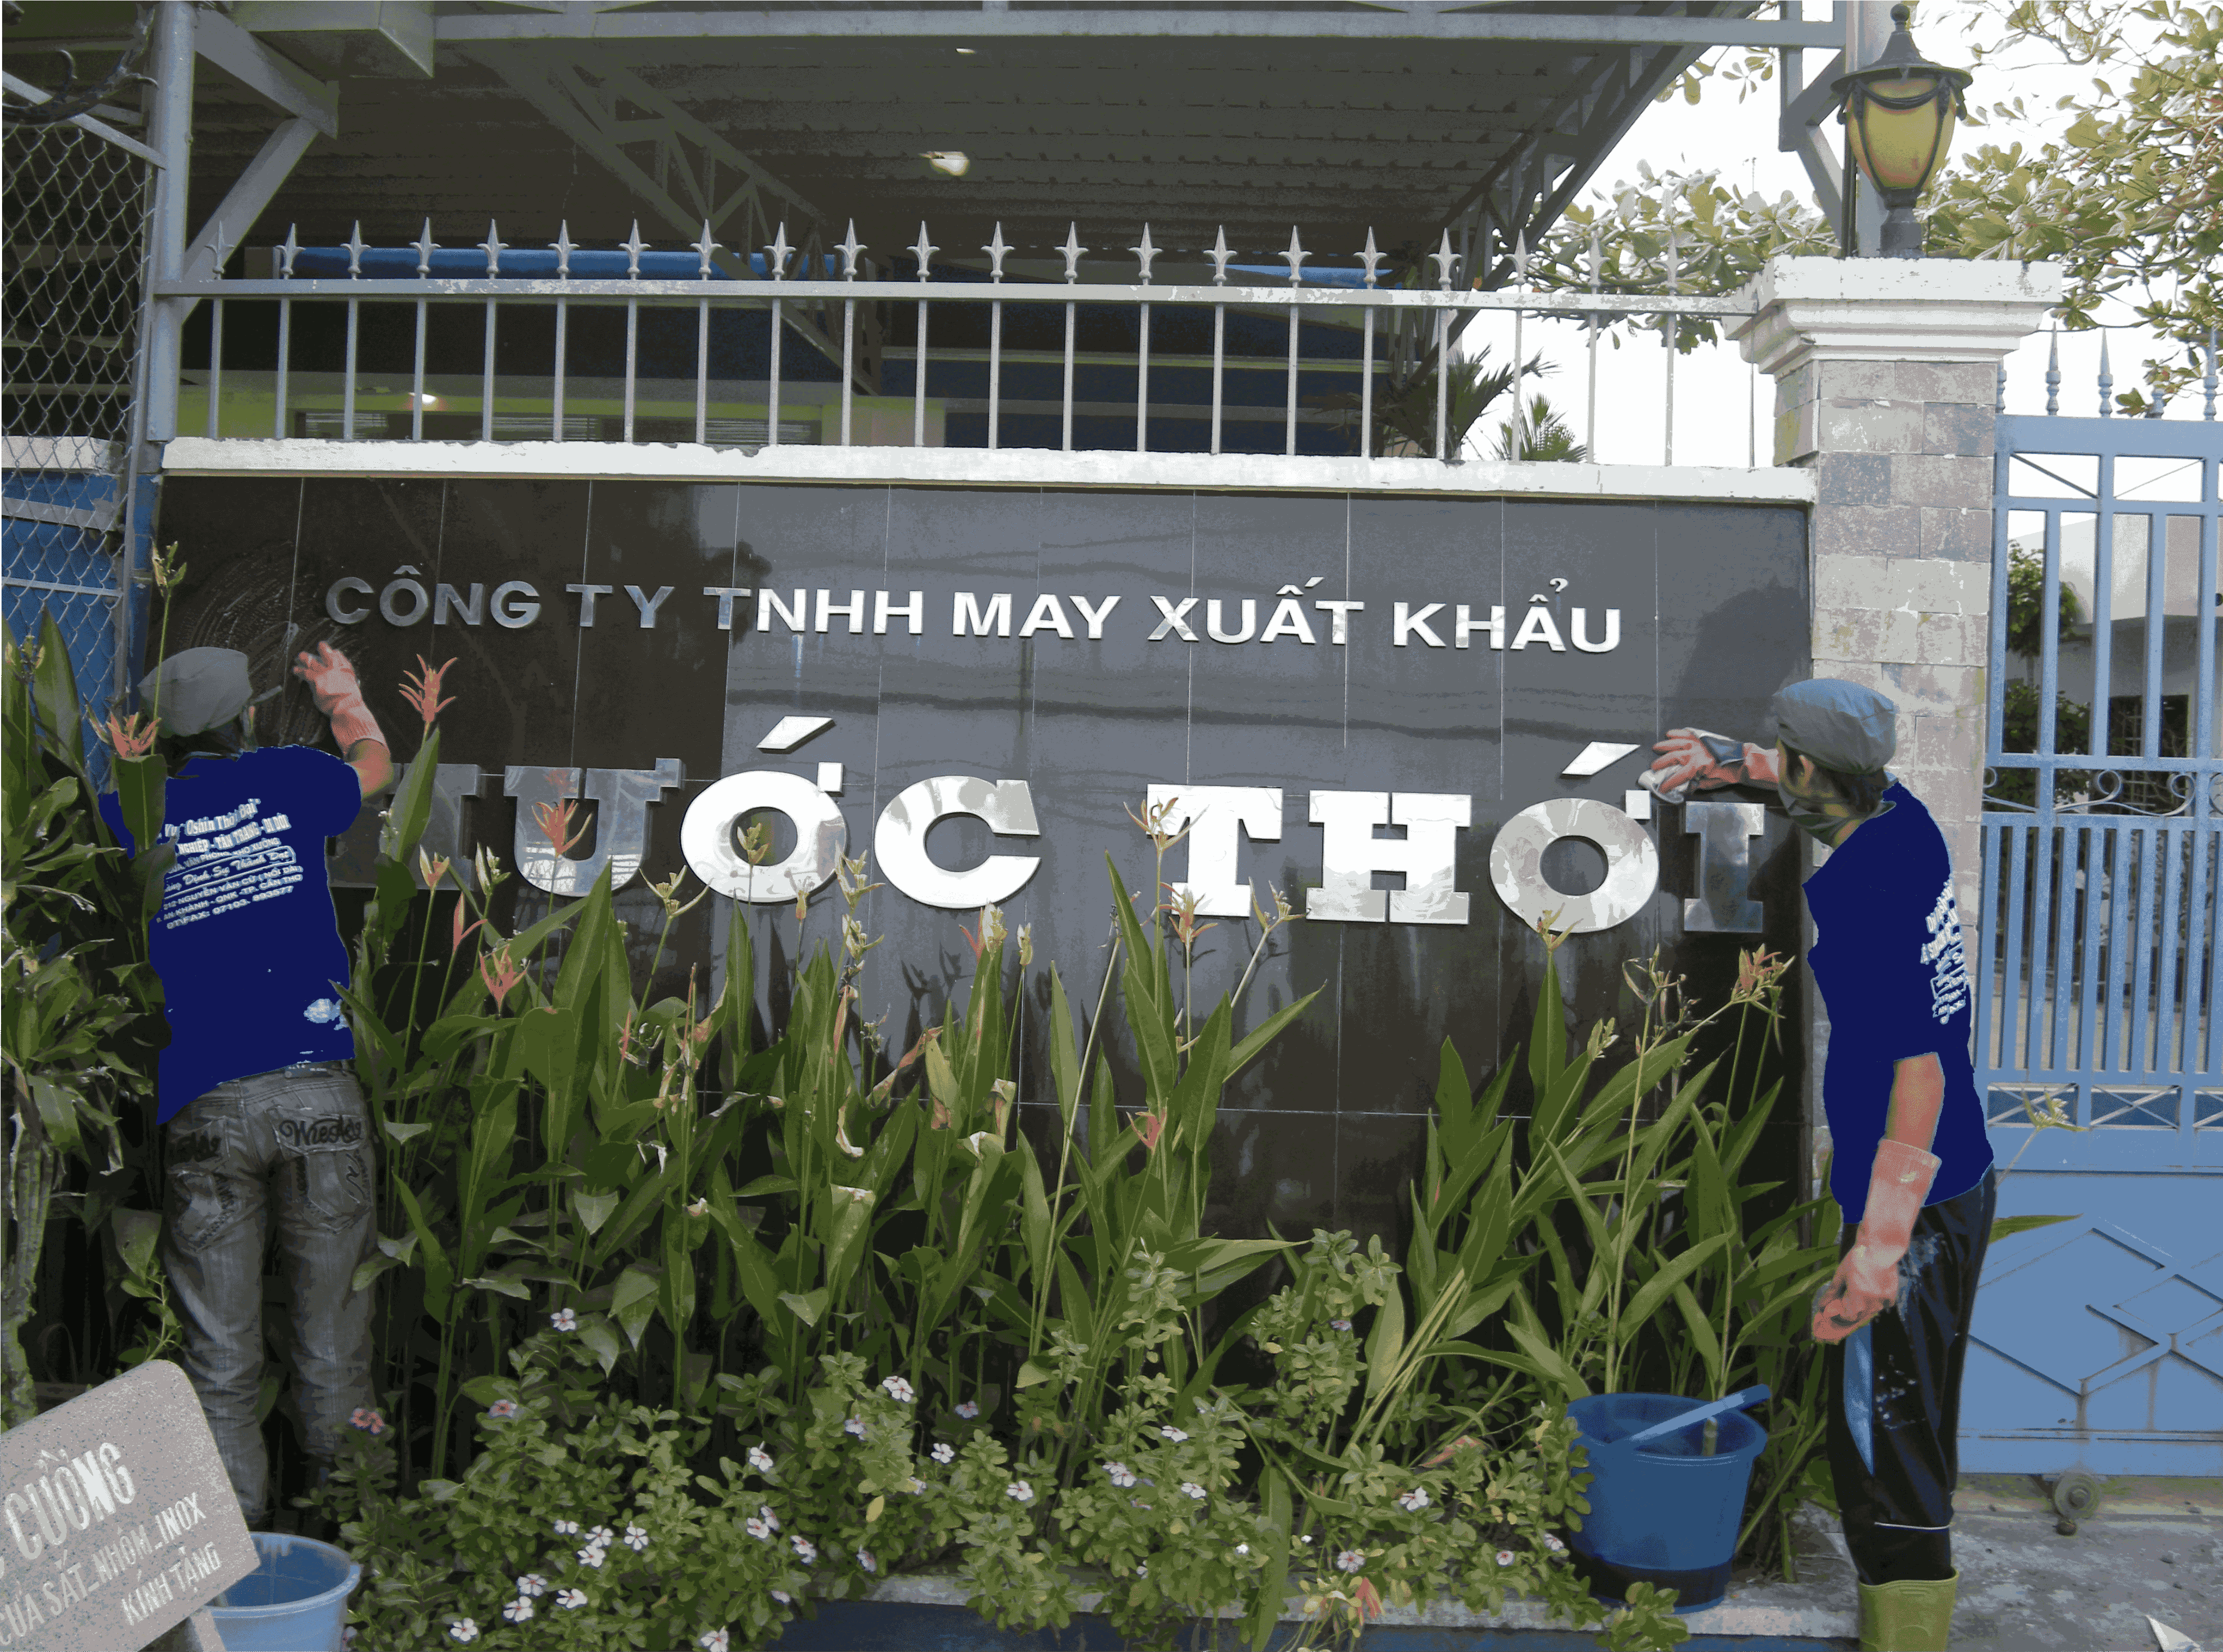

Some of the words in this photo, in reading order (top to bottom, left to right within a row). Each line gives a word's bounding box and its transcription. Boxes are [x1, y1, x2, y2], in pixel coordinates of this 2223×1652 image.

[326, 565, 540, 629] CÔNG
[565, 583, 675, 628] TY
[703, 586, 924, 635] TNHH
[952, 591, 1121, 639] MAY
[1147, 576, 1365, 645] XUẤT
[1392, 577, 1621, 653] KHẨU
[1146, 741, 1765, 934] THỚI
[121, 1568, 174, 1626] KÍNH
